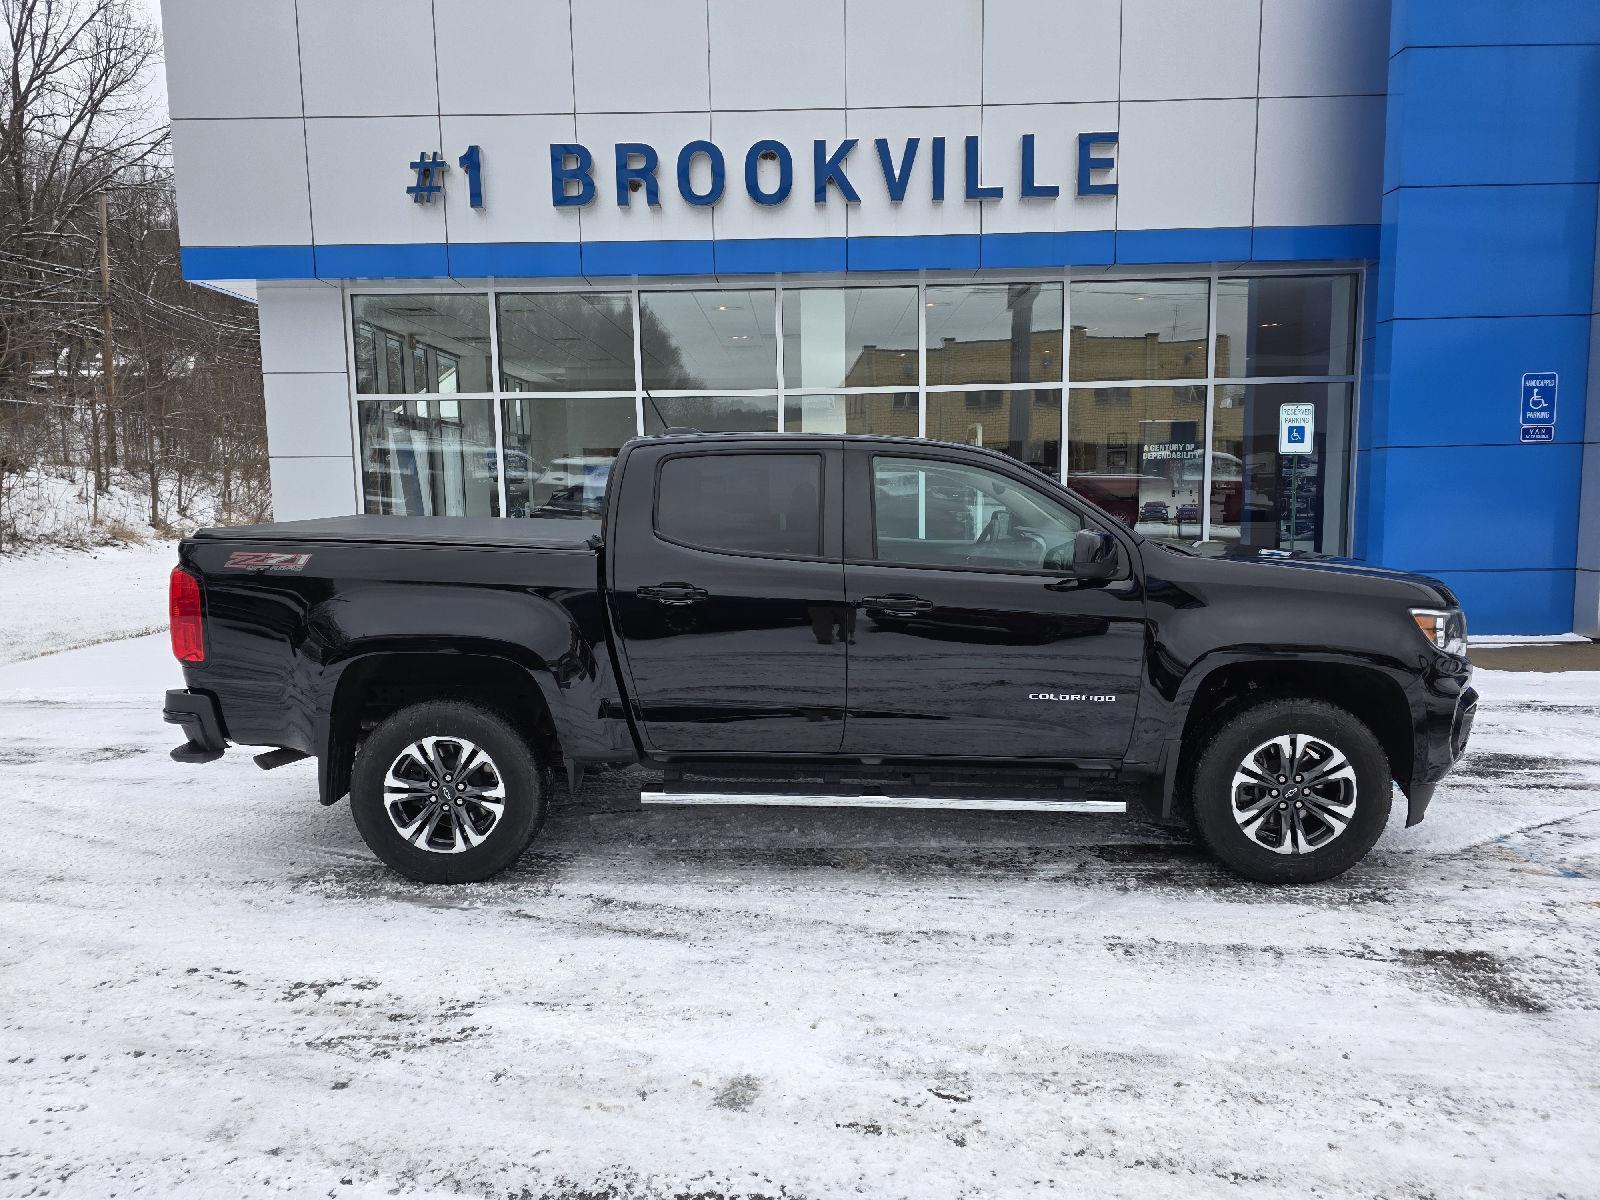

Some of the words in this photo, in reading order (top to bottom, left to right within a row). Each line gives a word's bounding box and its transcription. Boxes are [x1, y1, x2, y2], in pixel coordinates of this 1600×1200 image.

[405, 144, 485, 209] #1
[550, 132, 1120, 208] BROOKVILLE
[1284, 408, 1312, 416] RESERVED
[1526, 411, 1550, 419] PARKING
[1143, 444, 1149, 452] A
[1150, 443, 1184, 452] CENTURY
[1185, 443, 1195, 451] OF
[1142, 451, 1200, 459] DEPENDABILITY
[223, 551, 313, 568] Z71
[1028, 693, 1116, 702] COLORADO
